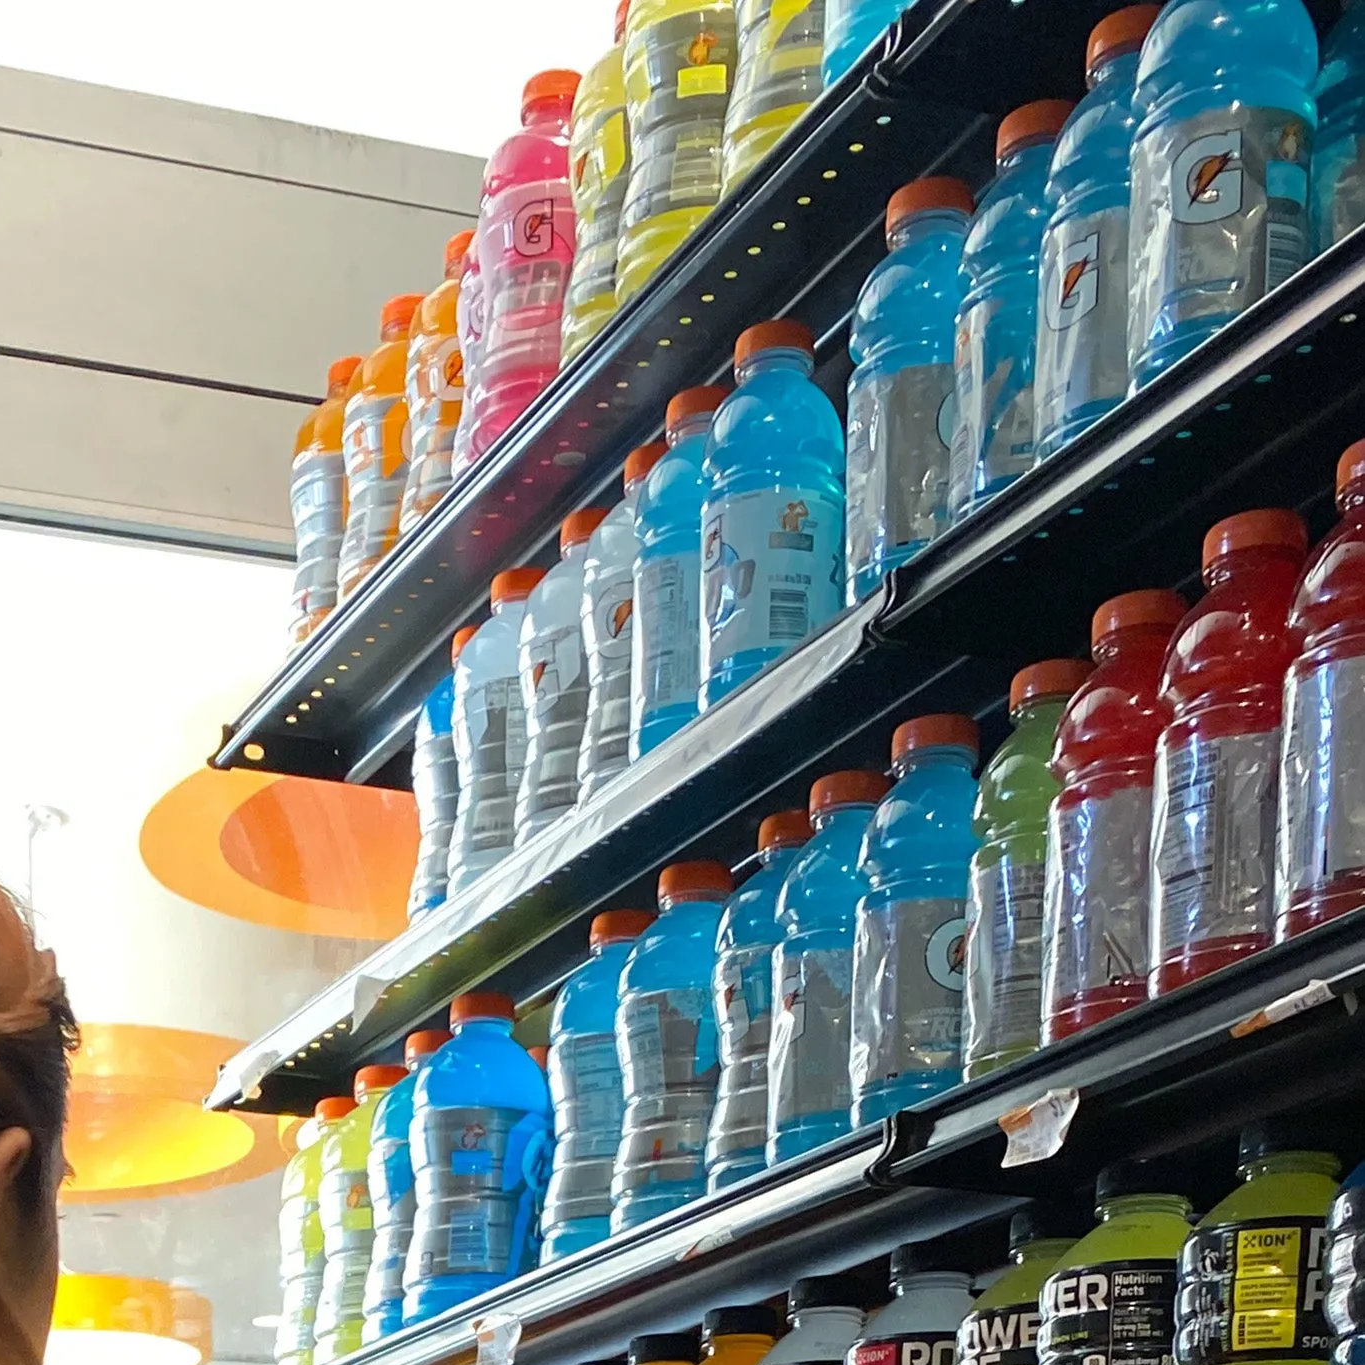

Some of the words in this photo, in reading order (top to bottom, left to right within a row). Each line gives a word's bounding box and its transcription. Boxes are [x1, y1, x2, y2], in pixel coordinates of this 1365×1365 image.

[1171, 128, 1243, 224] G
[1115, 1272, 1163, 1286] Nutrition
[1115, 1286, 1145, 1297] Facts
